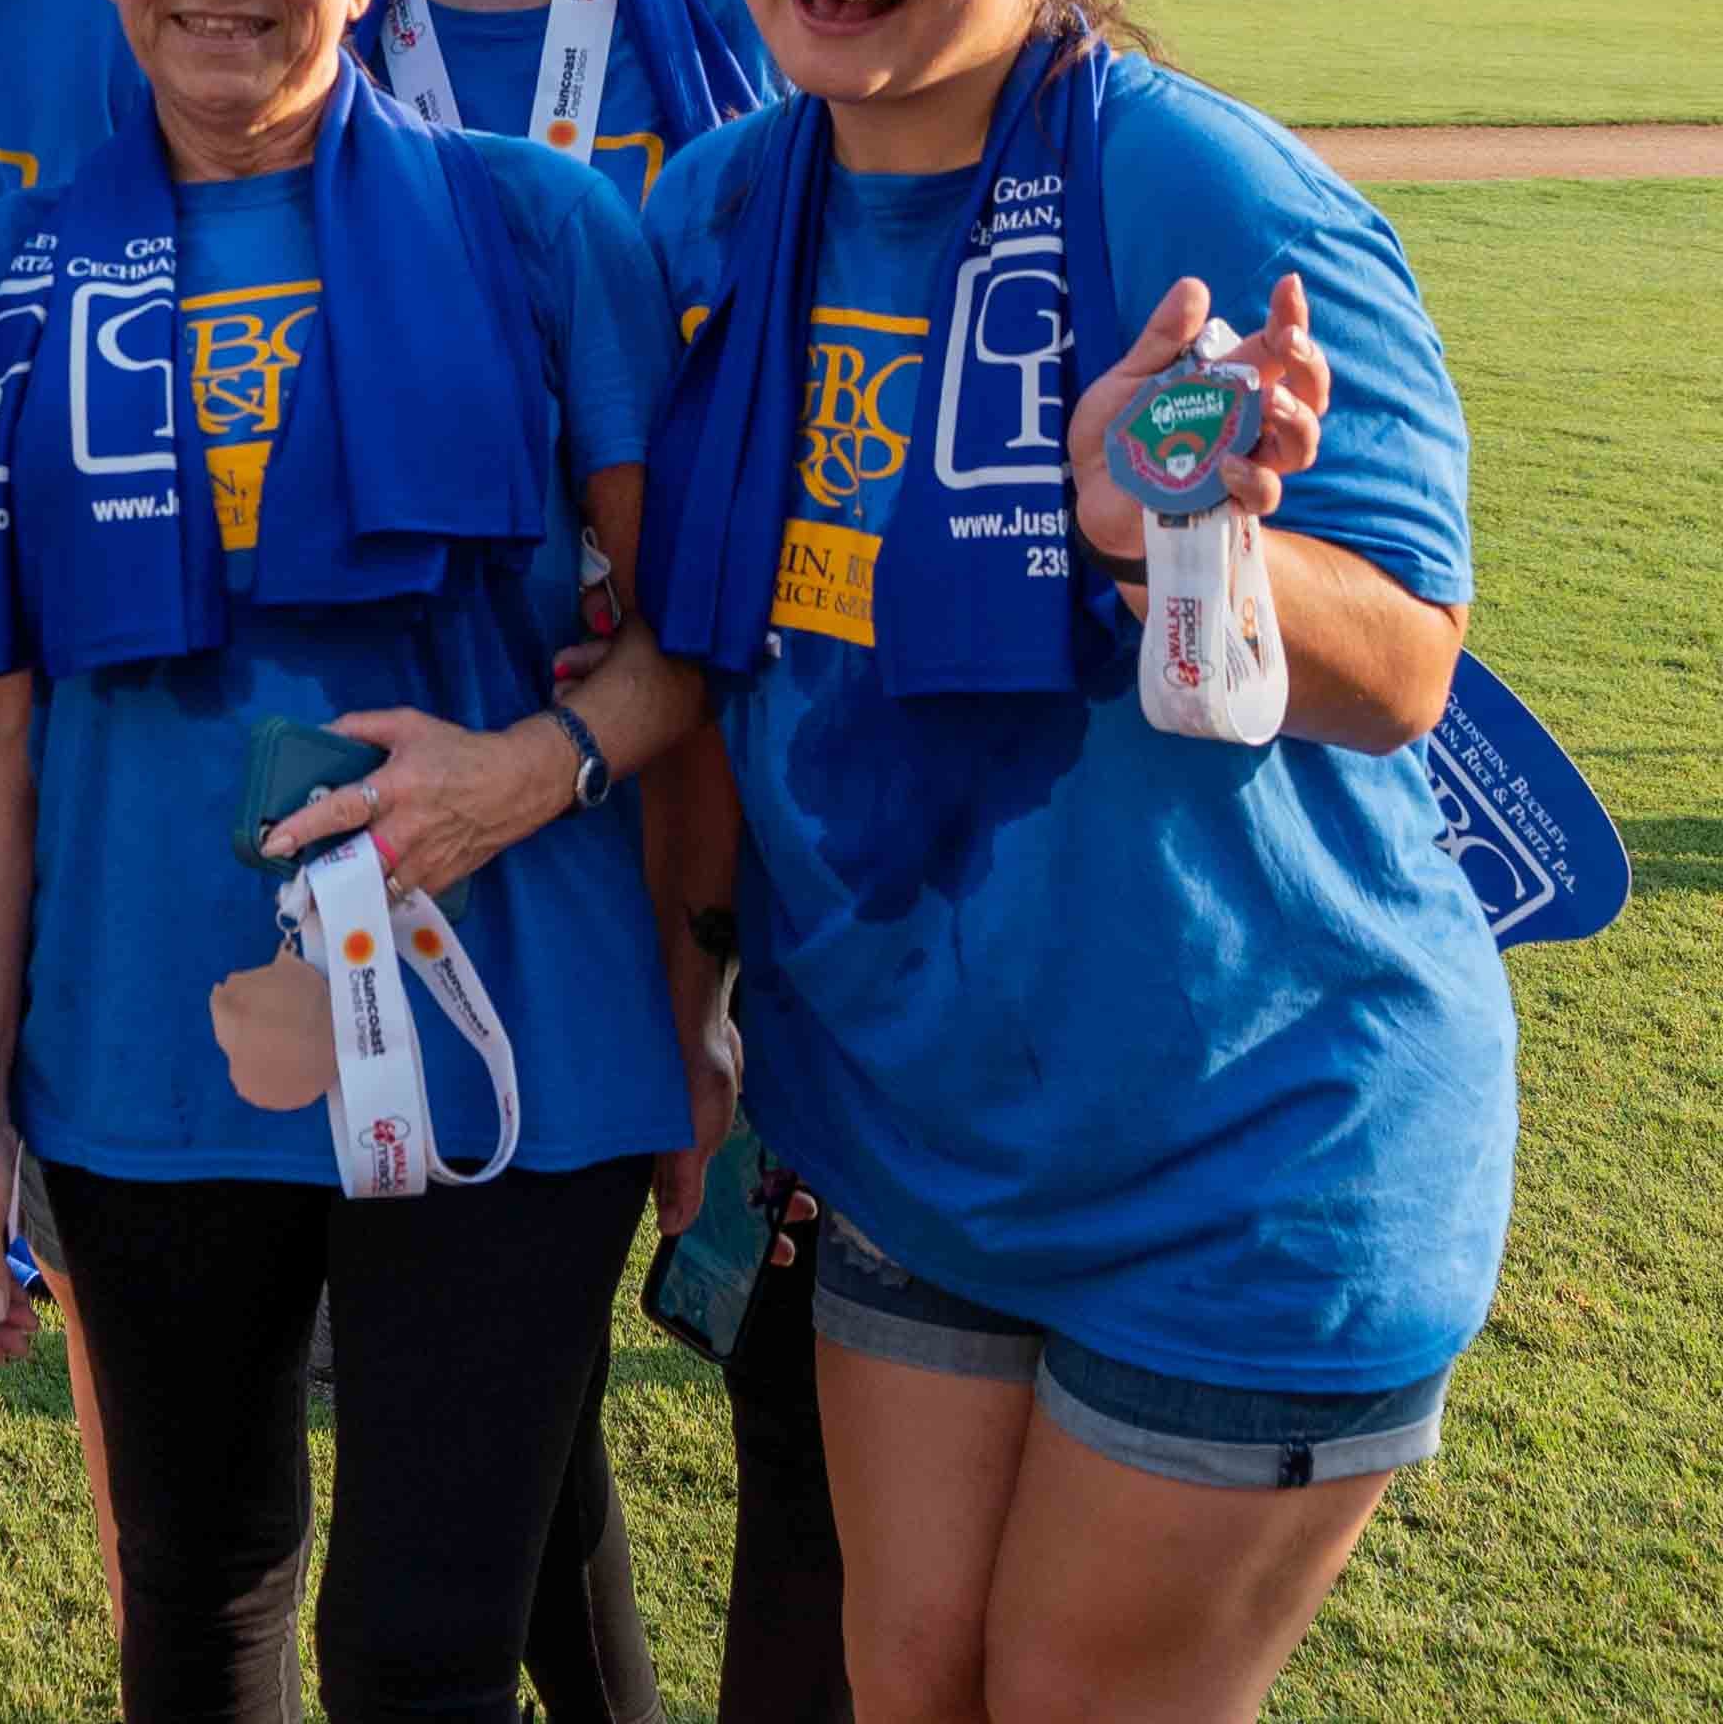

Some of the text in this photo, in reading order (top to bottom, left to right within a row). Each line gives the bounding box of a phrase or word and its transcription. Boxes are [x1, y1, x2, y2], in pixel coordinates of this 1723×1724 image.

[553, 47, 578, 118] Suncoast
[1461, 746, 1495, 788] RICE
[1492, 786, 1509, 807] &
[1507, 802, 1552, 862] PURTZ,
[1509, 776, 1568, 853] BUCKLEY,
[361, 966, 386, 1057] Suncoast
